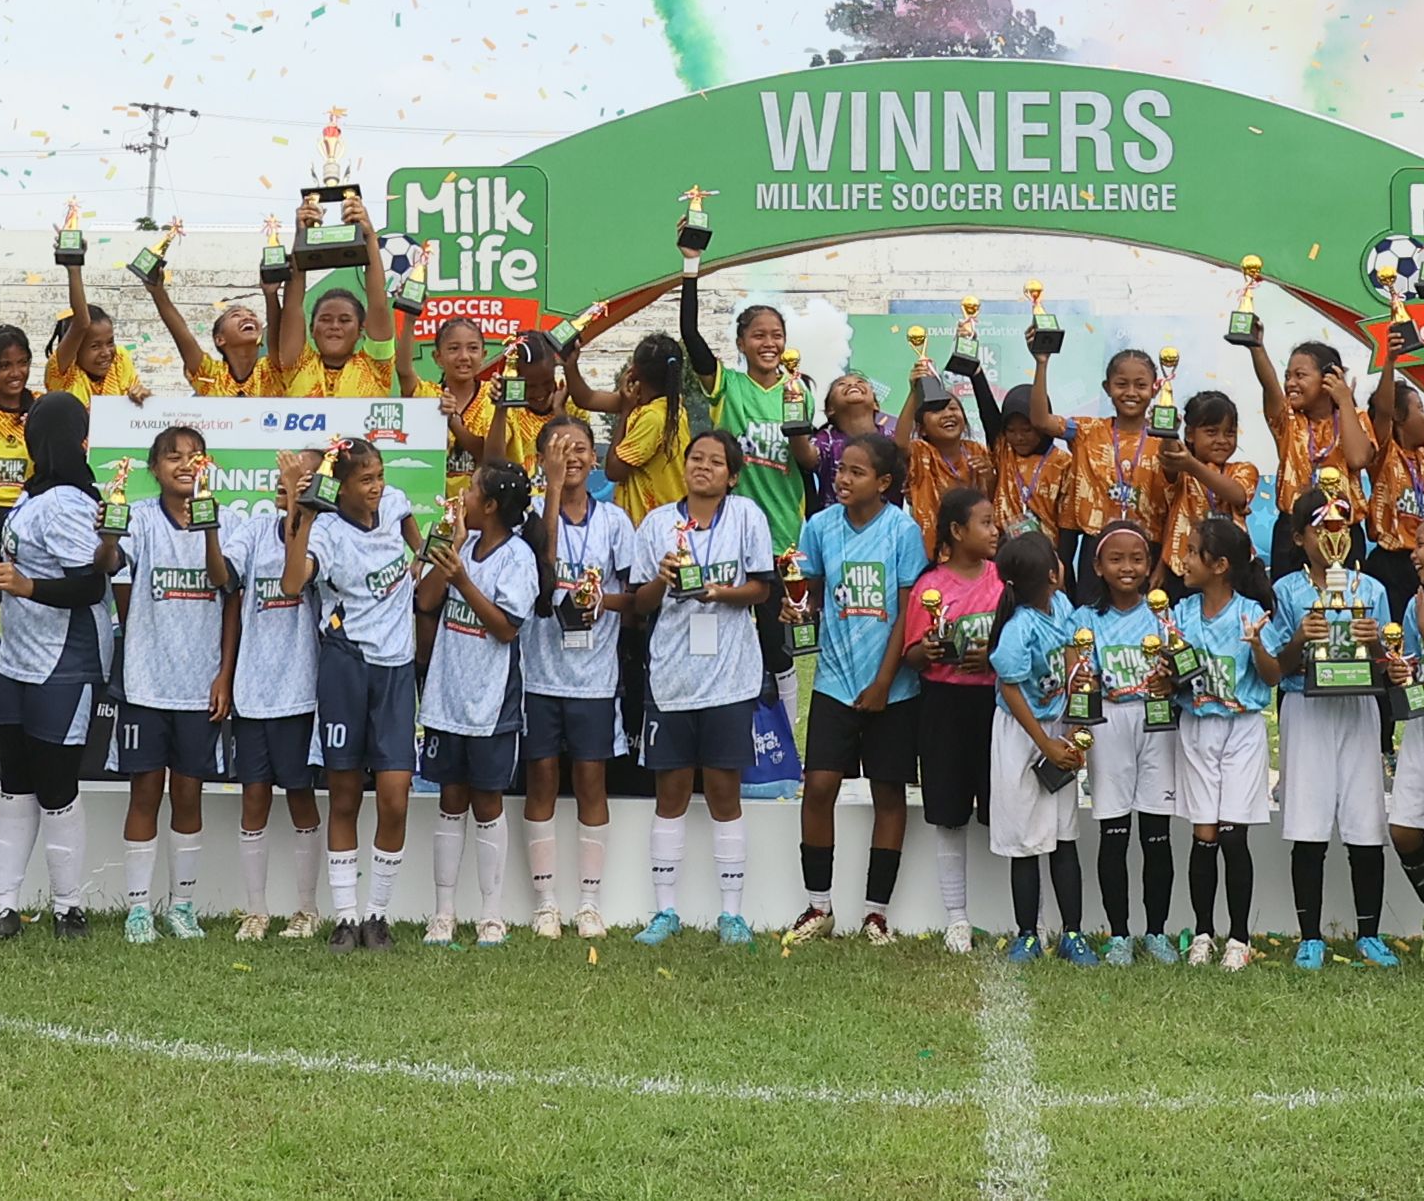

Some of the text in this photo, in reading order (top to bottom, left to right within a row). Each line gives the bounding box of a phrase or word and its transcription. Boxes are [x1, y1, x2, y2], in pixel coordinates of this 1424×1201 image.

[760, 89, 1174, 173] WINNERS
[406, 177, 533, 236] Milk
[757, 183, 1177, 212] MILKLIFE SOCCER CHALLENGE
[427, 234, 538, 292] Life
[427, 300, 503, 317] SOCCER
[413, 318, 520, 336] CHENGE
[283, 414, 326, 431] BCA
[373, 404, 401, 418] Milk
[377, 417, 401, 430] Life
[755, 439, 789, 463] Life
[847, 585, 884, 609] Life
[1105, 647, 1150, 671] Milk
[123, 724, 139, 750] 11
[324, 723, 347, 749] 10
[649, 721, 660, 747] 7
[426, 735, 440, 759] 8
